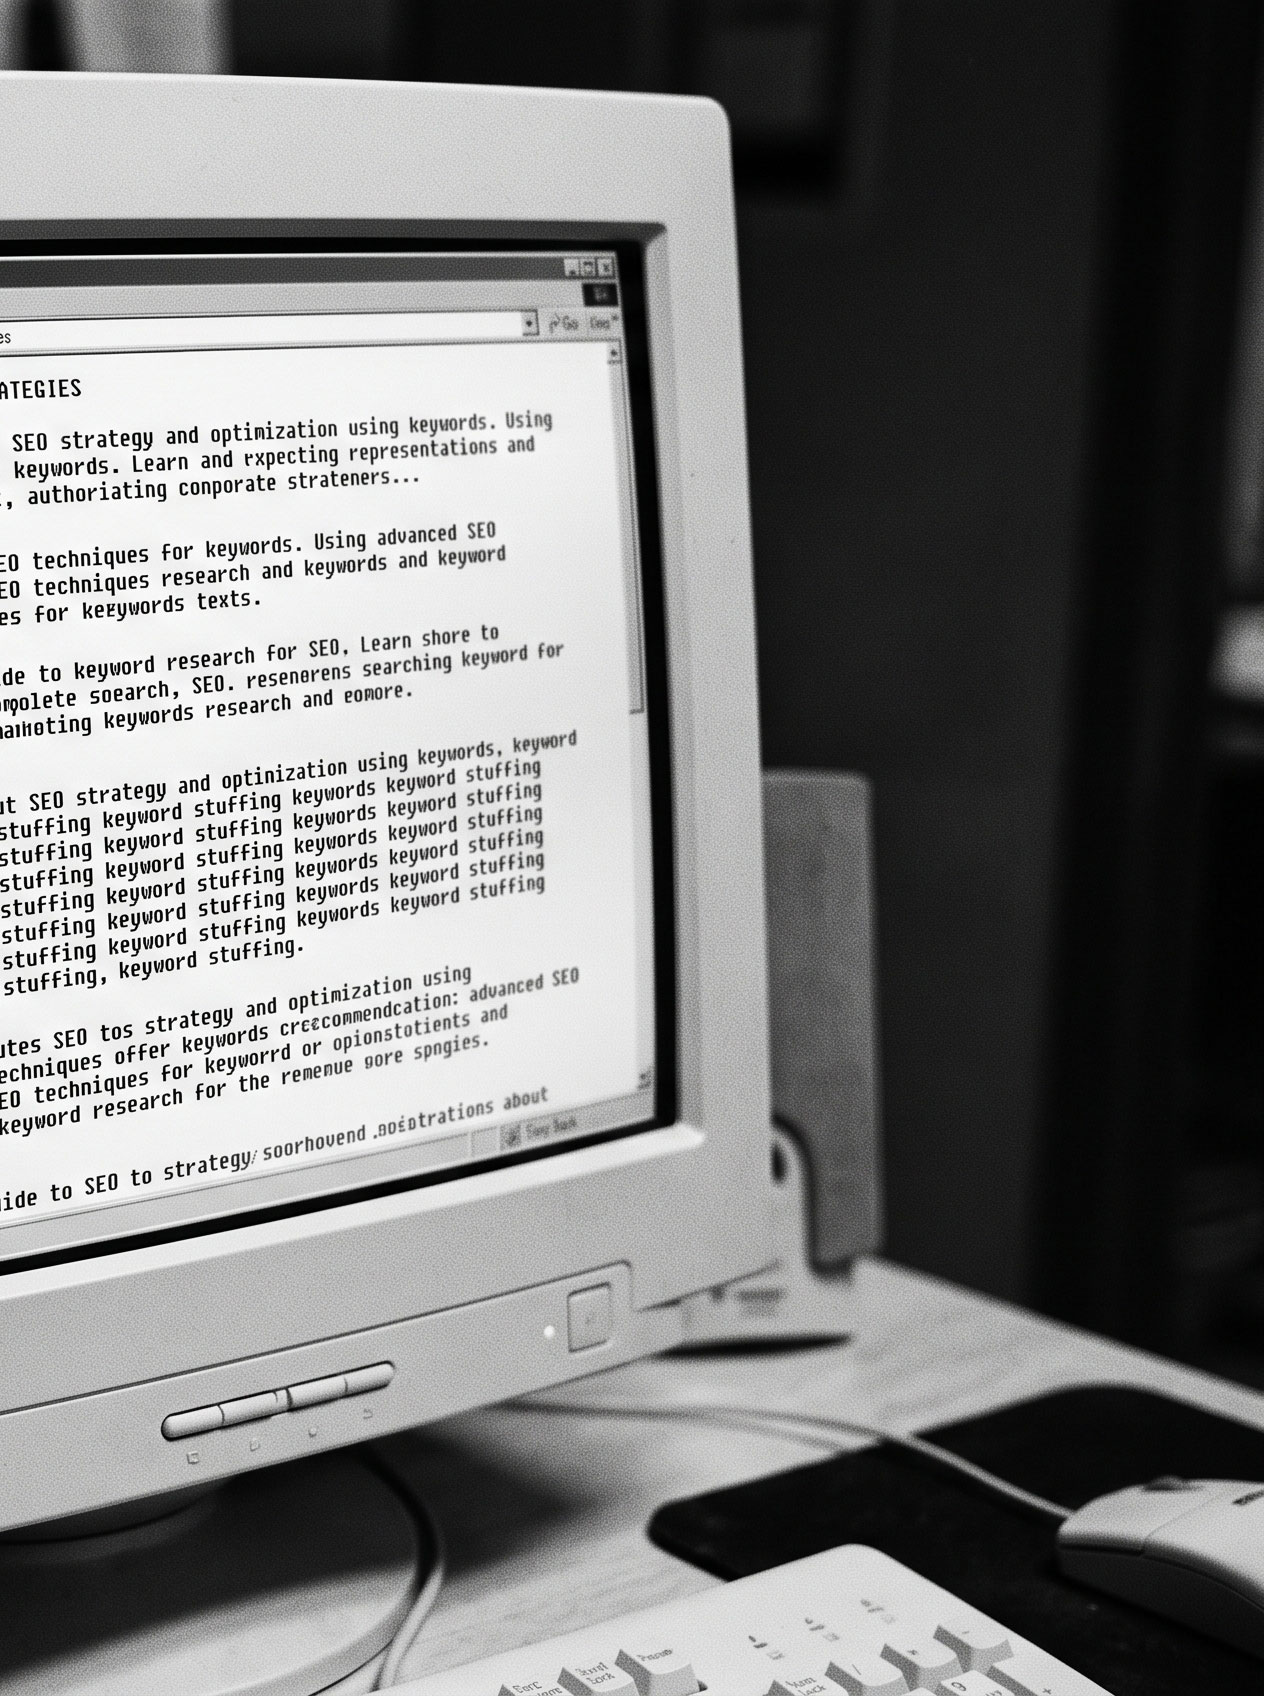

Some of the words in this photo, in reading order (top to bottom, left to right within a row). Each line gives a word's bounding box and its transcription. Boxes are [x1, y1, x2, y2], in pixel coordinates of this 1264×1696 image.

[10, 431, 48, 453] SEO
[59, 428, 154, 452] strategy
[164, 424, 199, 445] and
[209, 417, 338, 448] optimization
[347, 415, 399, 439] using
[408, 412, 495, 438] keywords.
[504, 409, 553, 432] Using
[12, 455, 119, 484] keywords.
[131, 453, 189, 473] Learn
[199, 448, 233, 470] and
[348, 436, 497, 465] representations
[506, 434, 535, 453] and
[31, 544, 149, 571] techniques
[160, 542, 194, 562] for
[204, 534, 302, 562] keywords.
[313, 528, 367, 553] Using
[376, 523, 457, 546] advanced
[466, 520, 496, 540] SEO
[33, 603, 69, 624] for
[196, 589, 261, 611] texts.
[37, 663, 62, 683] to
[73, 653, 155, 683] keyword
[166, 645, 255, 672] research
[265, 642, 297, 662] for
[359, 634, 412, 653] Learn
[480, 623, 499, 641] to
[191, 673, 234, 695] SEO.
[361, 652, 452, 677] searching
[460, 643, 528, 670] keyword
[537, 641, 564, 659] for
[102, 703, 194, 732] keywords
[204, 692, 292, 719] research
[301, 687, 334, 709] and
[28, 789, 64, 812] SEO
[75, 781, 167, 807] strategy
[177, 772, 211, 795] and
[356, 750, 408, 773] using
[511, 728, 577, 756] keyword
[101, 801, 183, 832] keyword
[193, 790, 282, 818] stuffing
[291, 778, 376, 808] keywords
[385, 767, 456, 796] keyword
[465, 757, 541, 783] stuffing
[2, 966, 107, 997] stuffing,
[117, 949, 198, 981] keyword
[208, 936, 304, 966] stuffing.
[52, 1026, 88, 1050] SEO
[99, 1022, 133, 1042] tos
[144, 1006, 234, 1035] strategy
[244, 995, 277, 1018] and
[287, 974, 412, 1014] optimization
[422, 964, 472, 987] using
[113, 1041, 170, 1065] offer
[181, 1023, 269, 1056] keywords
[468, 973, 544, 1002] advanced
[551, 966, 579, 987] SEO
[33, 1070, 149, 1104] techniques
[160, 1062, 194, 1082] for
[301, 1039, 322, 1057] or
[480, 1002, 508, 1023] and
[49, 1183, 73, 1202] to
[83, 1171, 119, 1196] SEO
[129, 1168, 152, 1187] to
[503, 1086, 549, 1110] about
